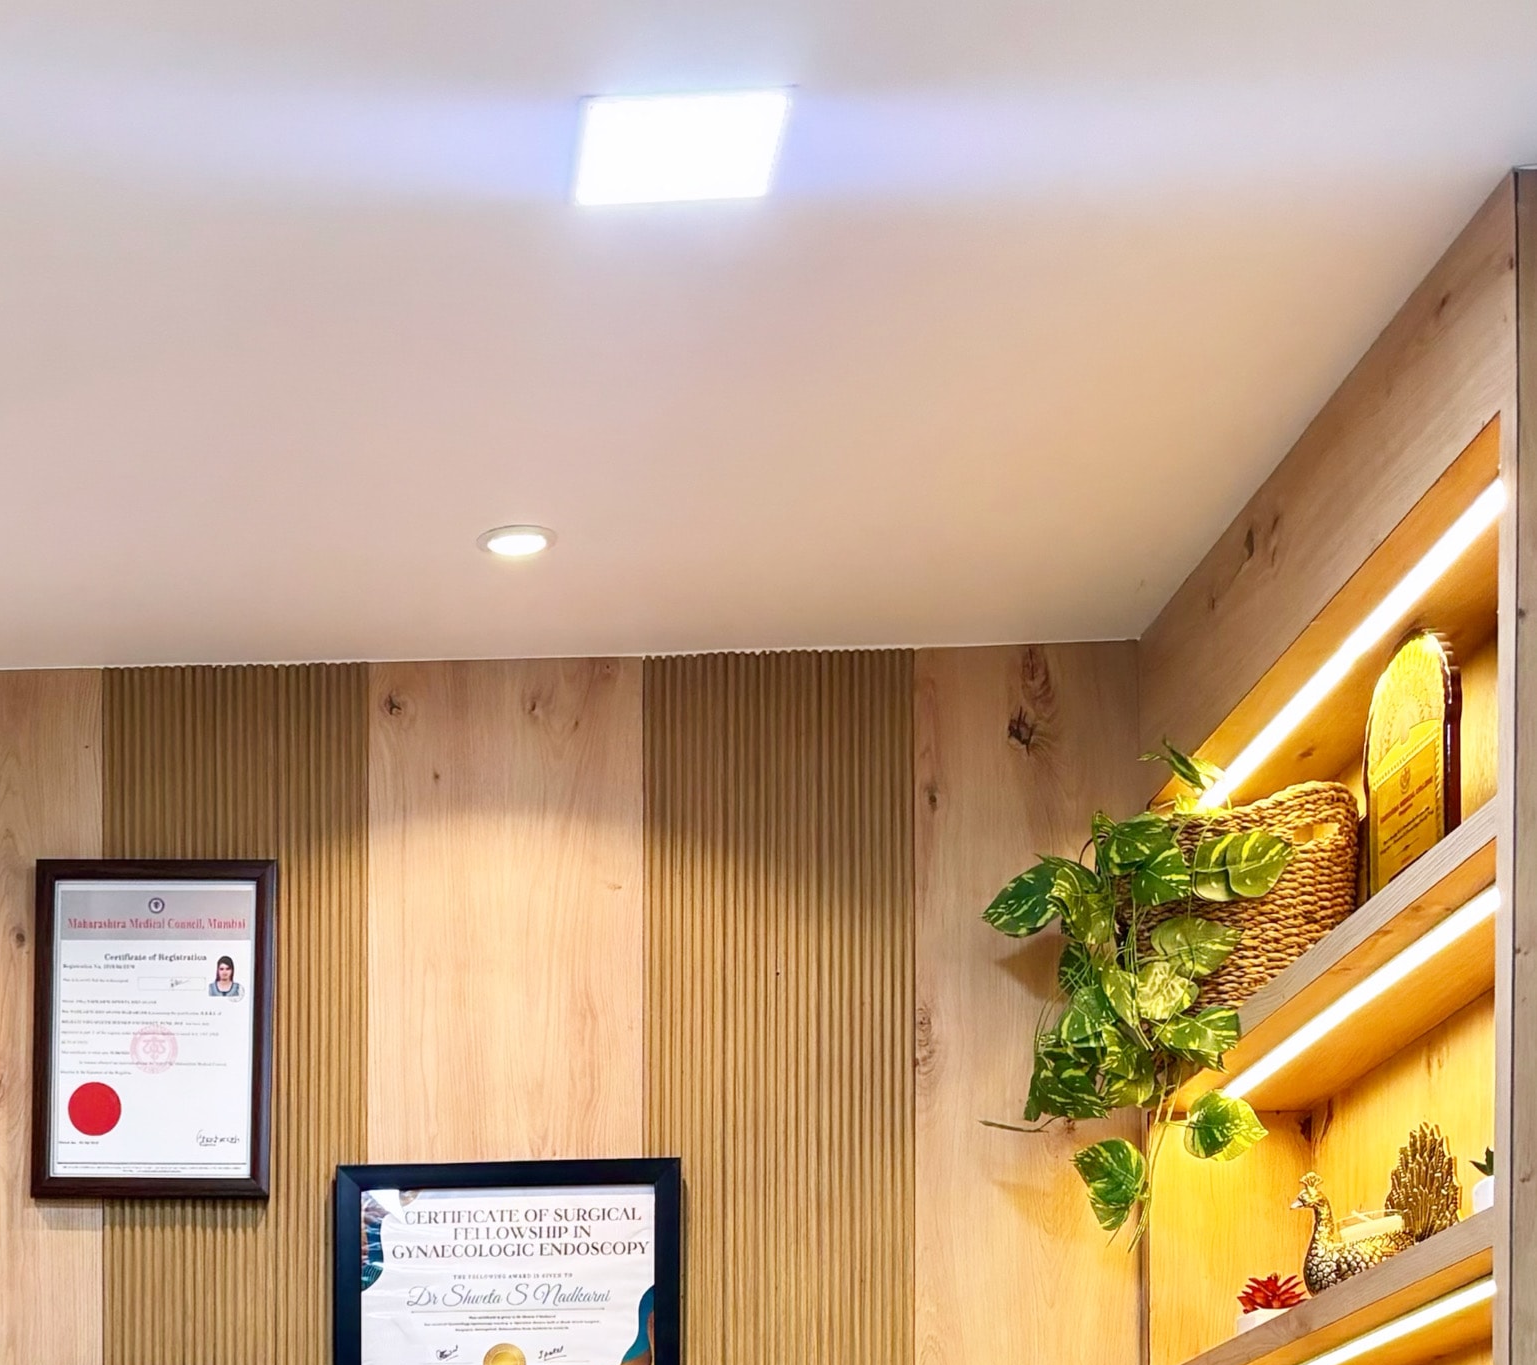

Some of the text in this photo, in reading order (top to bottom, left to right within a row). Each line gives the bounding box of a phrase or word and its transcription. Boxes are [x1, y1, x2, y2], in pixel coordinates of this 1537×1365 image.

[68, 918, 126, 928] Maharashtra
[130, 918, 164, 928] Medical
[149, 953, 156, 961] of
[405, 1207, 642, 1225] CERTIFICATE OF SURGICAL
[454, 1225, 591, 1241] FELLOWSHIP IN
[392, 1241, 650, 1260] GYNAECOLOGIC ENDOSCOPY
[407, 1283, 611, 1306] Dr Shweta S Nadkarni
